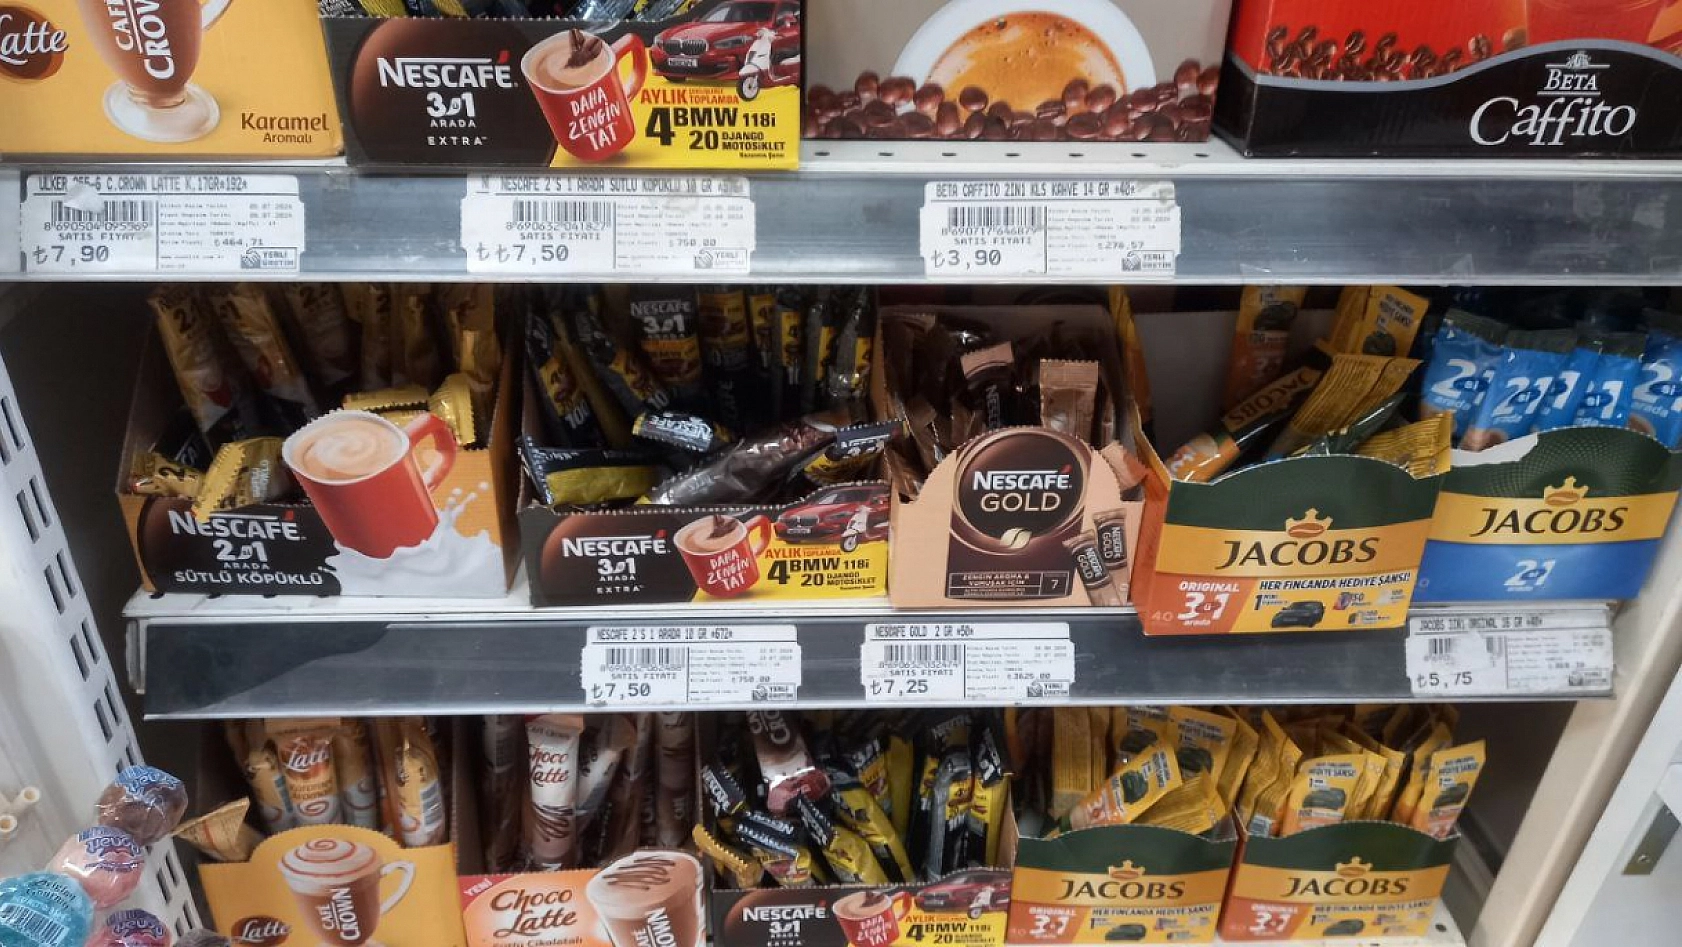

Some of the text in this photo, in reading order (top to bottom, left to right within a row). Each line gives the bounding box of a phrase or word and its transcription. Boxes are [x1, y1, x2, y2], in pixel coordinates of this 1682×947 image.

[1543, 68, 1598, 90] BETA
[570, 87, 608, 115] DAHA
[641, 89, 687, 104] AYLIK
[689, 95, 739, 105] TOPLAMDA
[241, 112, 329, 131] Karamel
[430, 119, 476, 128] ARADA
[645, 107, 776, 146] 4 BMW 118i
[1470, 96, 1636, 146] Caffito
[263, 132, 312, 143] Aromalı
[585, 130, 618, 151] TAT
[689, 130, 764, 150] 20 DJANGO
[151, 177, 181, 190] LATTE
[500, 177, 540, 191] NESCAFE
[577, 178, 604, 191] ARADA
[936, 184, 957, 197] BETA
[963, 183, 1000, 197] CAFFITO
[1005, 183, 1026, 197] 2IN1
[1052, 182, 1078, 196] KAHVE
[1084, 182, 1093, 196] 14
[1098, 182, 1109, 196] GR
[33, 245, 109, 265] ₺7,90
[931, 249, 1001, 270] ₺3,90
[980, 492, 1061, 512] GOLD
[1470, 507, 1628, 538] JACOBS
[765, 548, 801, 558] AYLIK
[1102, 532, 1113, 559] GOLD
[1215, 537, 1380, 569] JACOBS
[224, 562, 270, 570] ARADA
[710, 550, 740, 570] DAHA
[1078, 554, 1093, 579] GOLD
[175, 569, 323, 585] SÜTLÜ KÖPÜKLÜ
[767, 559, 869, 585] 4 BMW 118i
[801, 573, 824, 586] 20
[723, 573, 746, 591] TAT
[1051, 579, 1059, 589] 7
[1178, 580, 1239, 592] ORIGINAL
[1260, 580, 1282, 590] HER
[597, 628, 628, 640] NESCAFE
[659, 628, 681, 639] ARADA
[875, 625, 906, 637] NESCAFE
[910, 625, 927, 637] GOLD
[1420, 619, 1445, 631] JACOBS
[591, 683, 650, 700] ₺7,50
[870, 679, 928, 696] ₺7,25
[1058, 880, 1186, 900] JACOBS
[1281, 877, 1410, 898] JACOBS
[490, 888, 573, 914] Choco
[332, 887, 361, 940] CROWN
[493, 907, 577, 938] Latte
[240, 920, 292, 944] Latte
[906, 924, 924, 943] 4
[925, 922, 967, 932] BMW
[934, 934, 953, 944] 20
